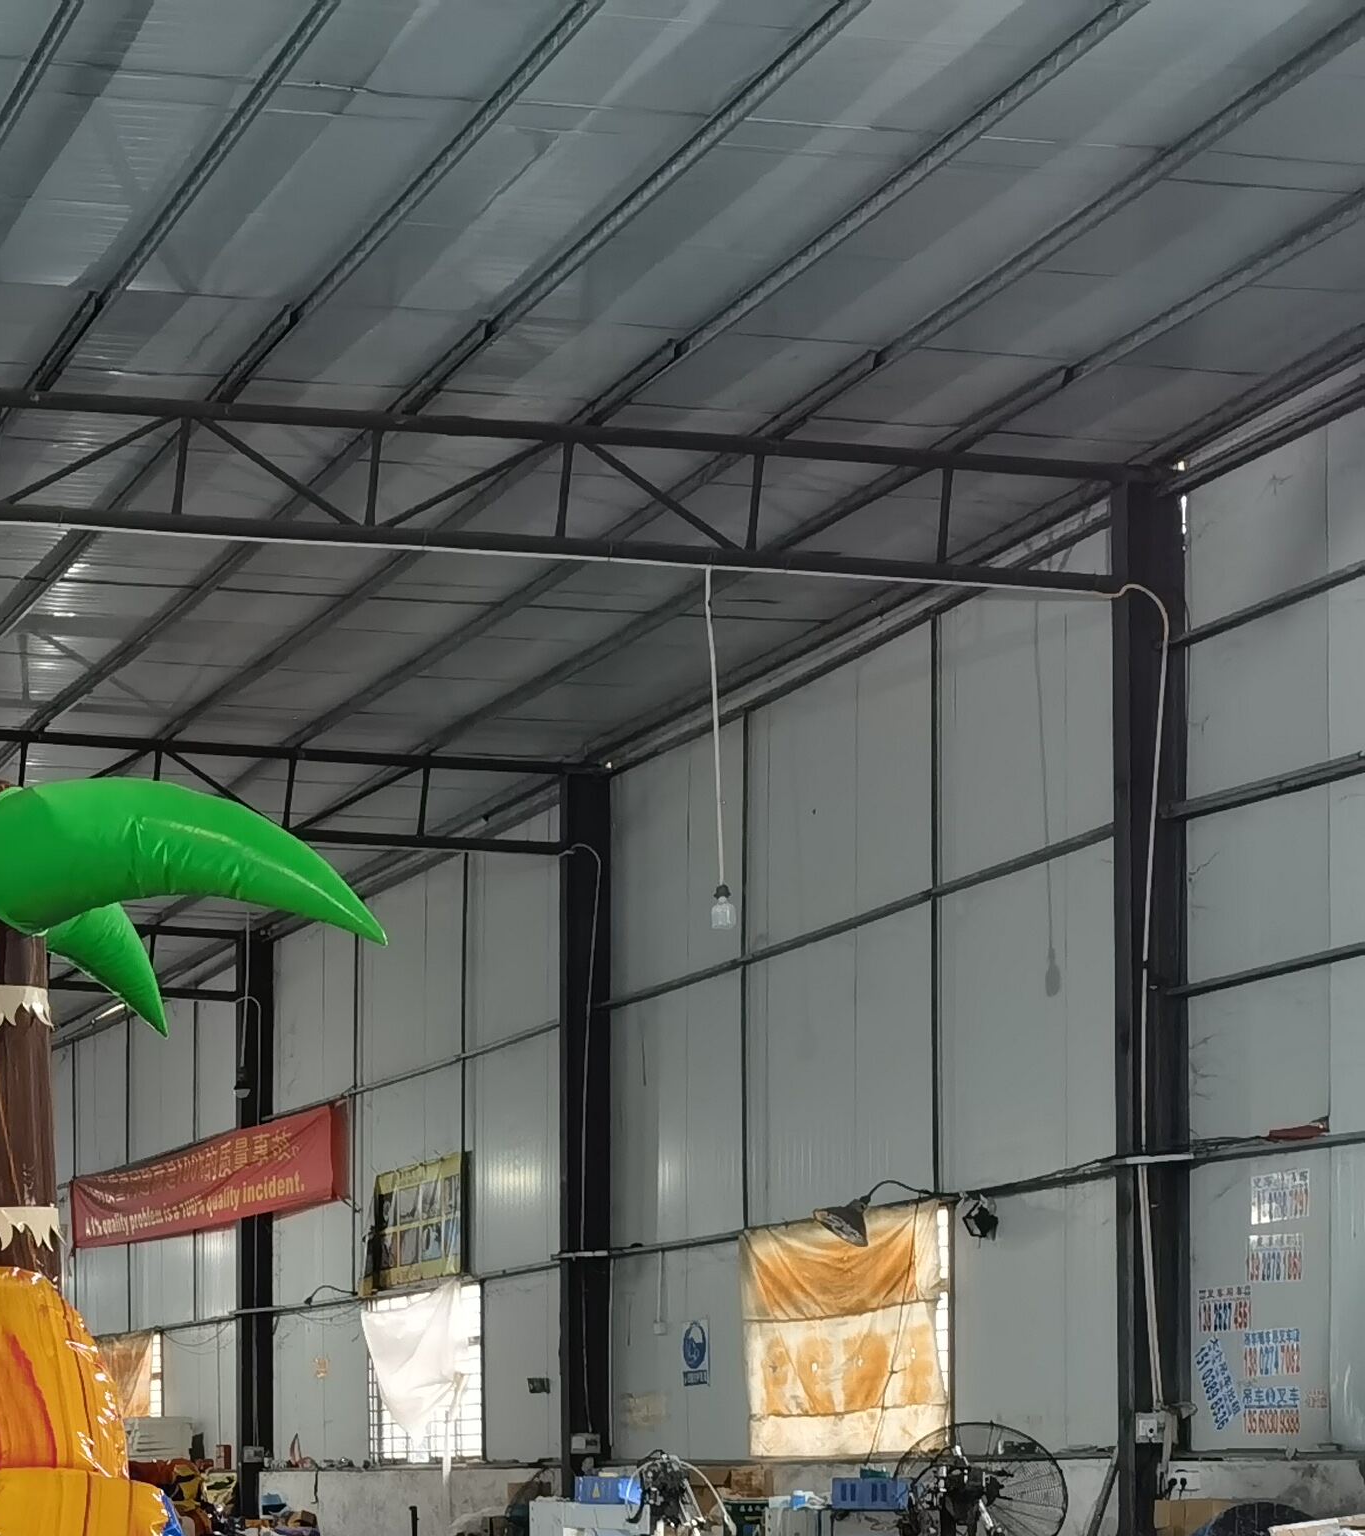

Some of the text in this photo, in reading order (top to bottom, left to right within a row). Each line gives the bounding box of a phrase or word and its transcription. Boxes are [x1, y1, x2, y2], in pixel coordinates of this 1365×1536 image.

[103, 1212, 129, 1237] quality
[130, 1206, 164, 1235] problem
[206, 1186, 241, 1218] quality
[243, 1170, 305, 1204] incident.
